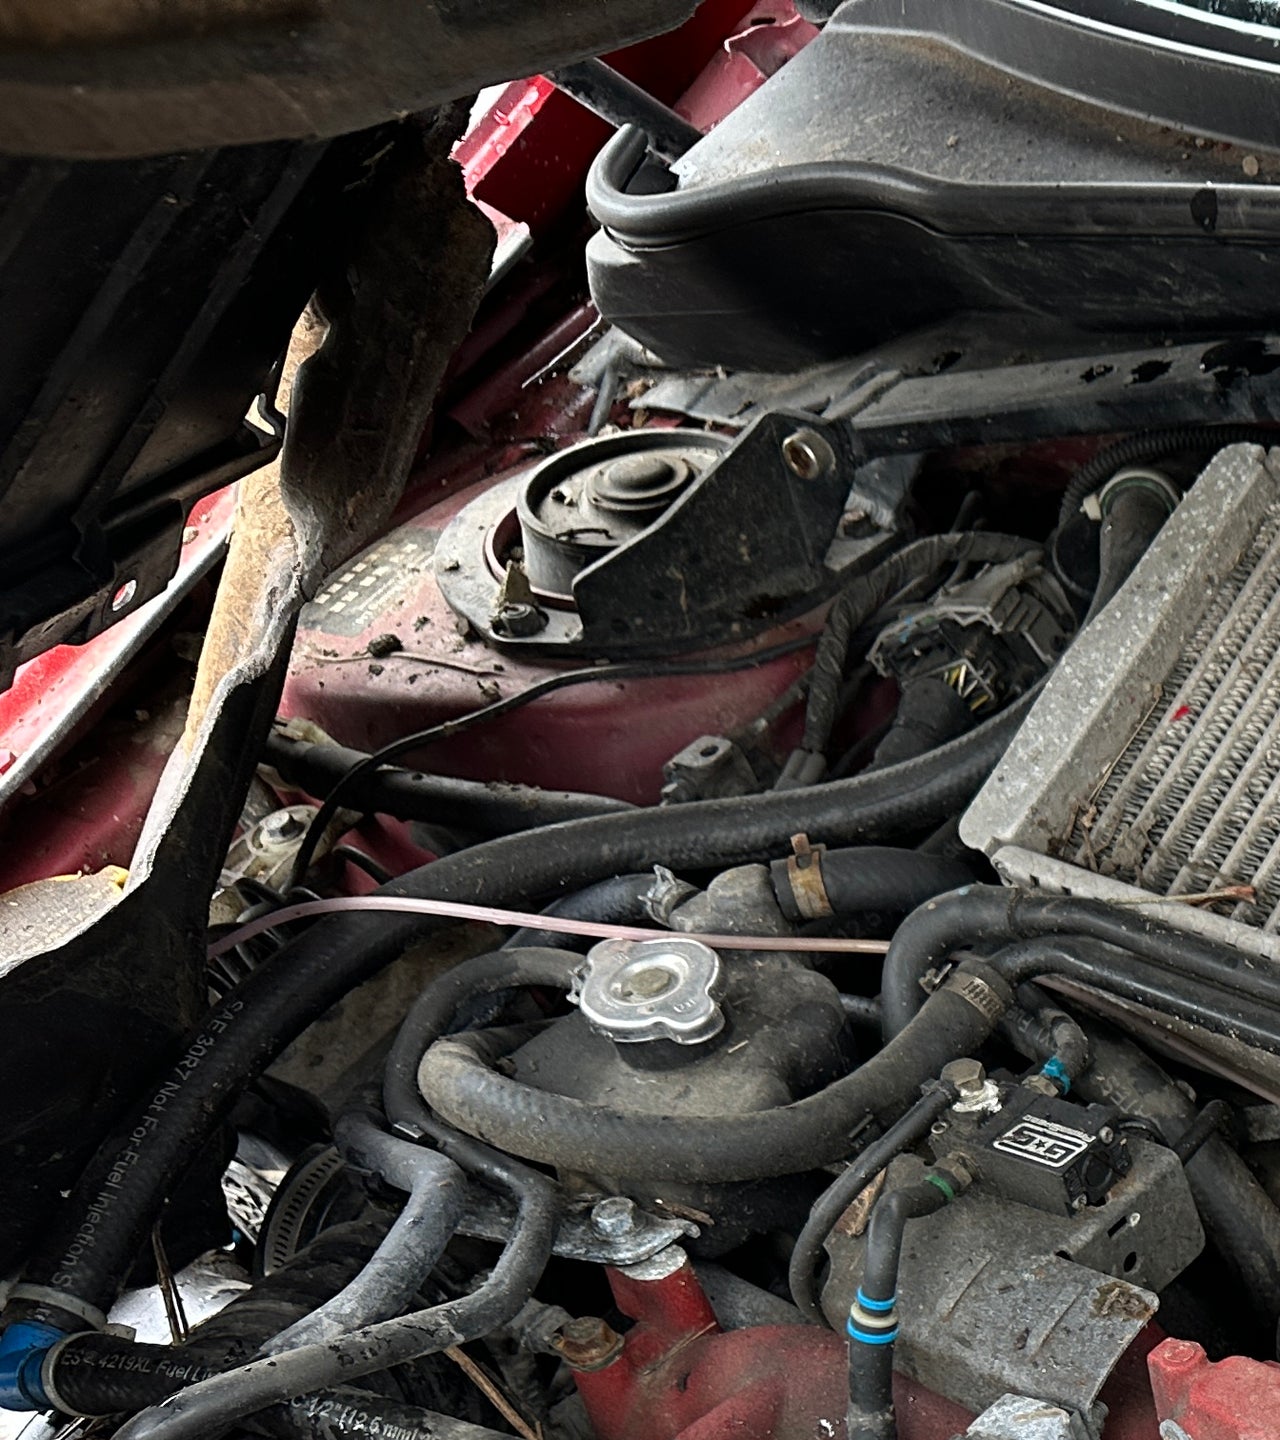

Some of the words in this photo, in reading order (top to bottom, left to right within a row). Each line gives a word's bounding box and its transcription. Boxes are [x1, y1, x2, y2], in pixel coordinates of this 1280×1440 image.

[209, 1000, 244, 1034] SAE
[174, 1034, 216, 1081] 30R7
[149, 1081, 182, 1112] Not
[129, 1114, 160, 1148] For
[105, 1150, 139, 1190] Fuel
[62, 1190, 118, 1267] Injection
[98, 1354, 151, 1373] 4219XL
[155, 1360, 192, 1380] Fuel
